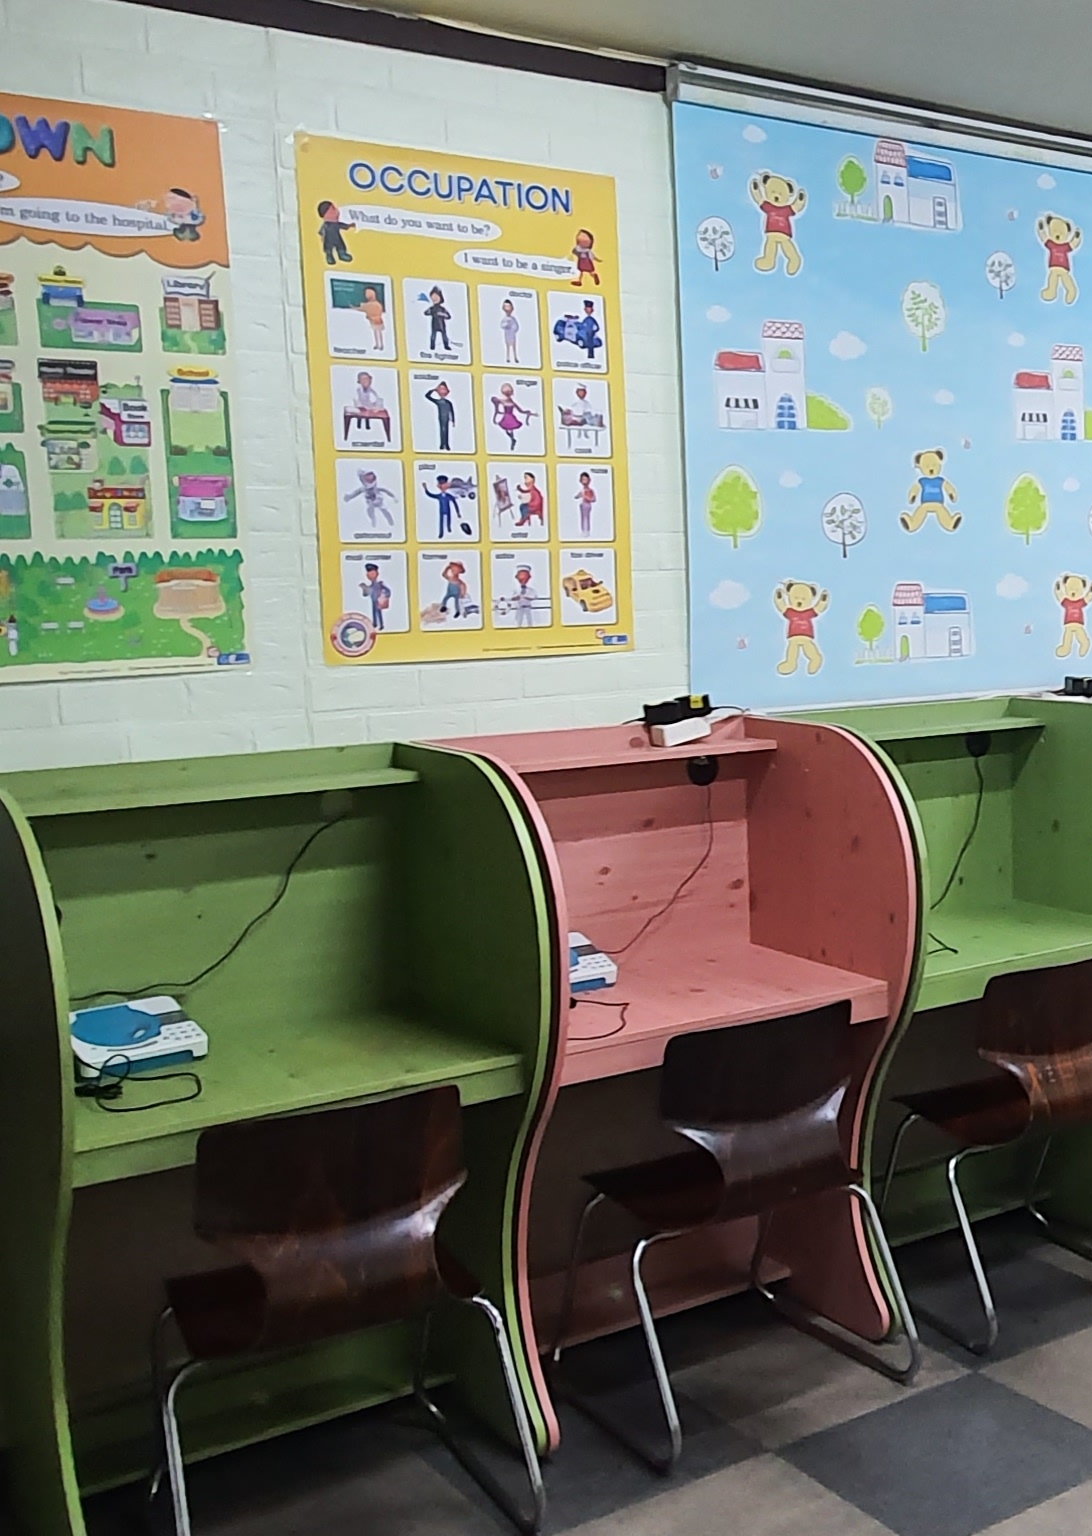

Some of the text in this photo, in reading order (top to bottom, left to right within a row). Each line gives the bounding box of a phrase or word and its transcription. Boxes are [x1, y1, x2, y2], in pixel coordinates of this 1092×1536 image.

[348, 162, 572, 213] OCCUPATION
[19, 206, 60, 224] going
[65, 211, 80, 223] to
[85, 212, 108, 226] the
[348, 209, 491, 237] What do you want to be?
[464, 252, 469, 263] I
[472, 255, 499, 267] want
[502, 257, 513, 267] to
[516, 258, 529, 269] be
[531, 262, 538, 270] a
